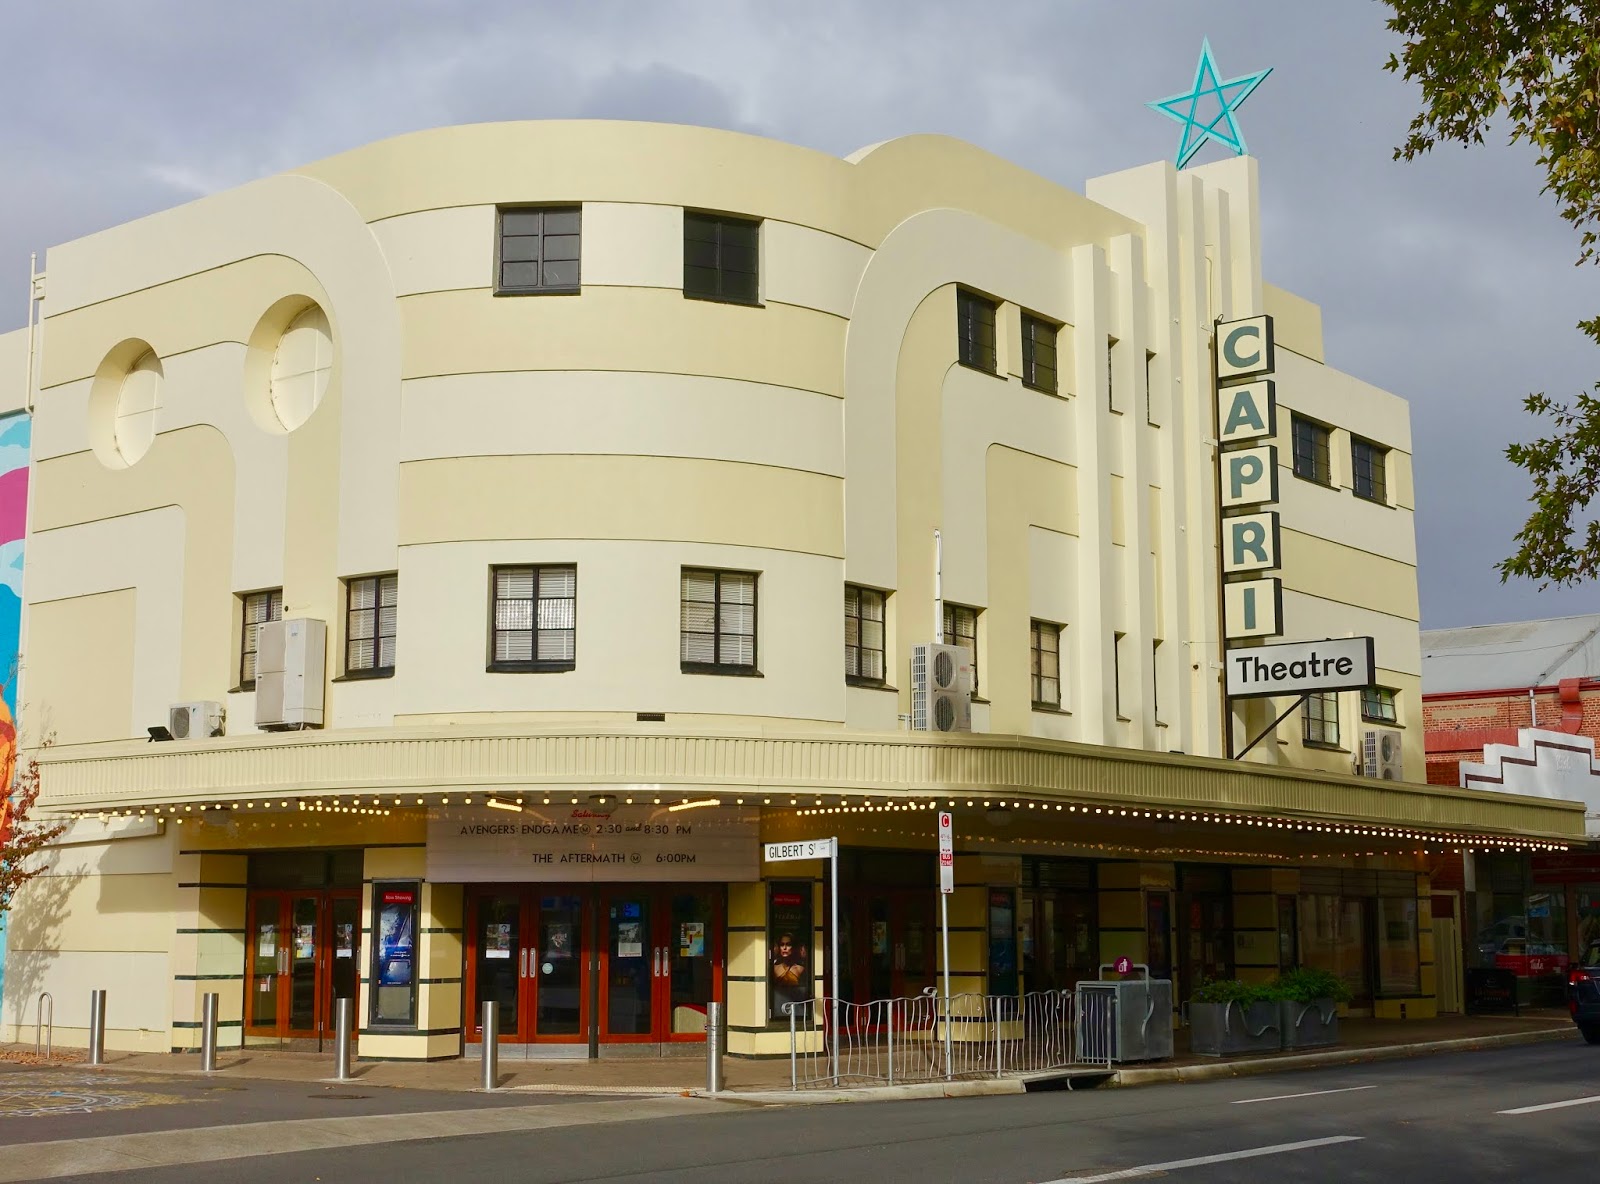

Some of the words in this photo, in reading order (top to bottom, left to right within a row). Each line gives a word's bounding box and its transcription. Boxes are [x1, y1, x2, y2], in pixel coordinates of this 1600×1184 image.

[1223, 326, 1268, 629] CAPRI
[1235, 652, 1353, 683] Theatre
[460, 824, 518, 835] AVENGERS:
[521, 824, 579, 835] ENDGAME
[596, 824, 622, 834] 2:30
[625, 823, 642, 832] and
[644, 824, 669, 835] 8:30
[676, 825, 692, 834] PM
[532, 853, 553, 863] THE
[560, 853, 626, 863] AFTERMATH
[656, 853, 696, 863] 6:00PM
[769, 844, 804, 858] GILBERT
